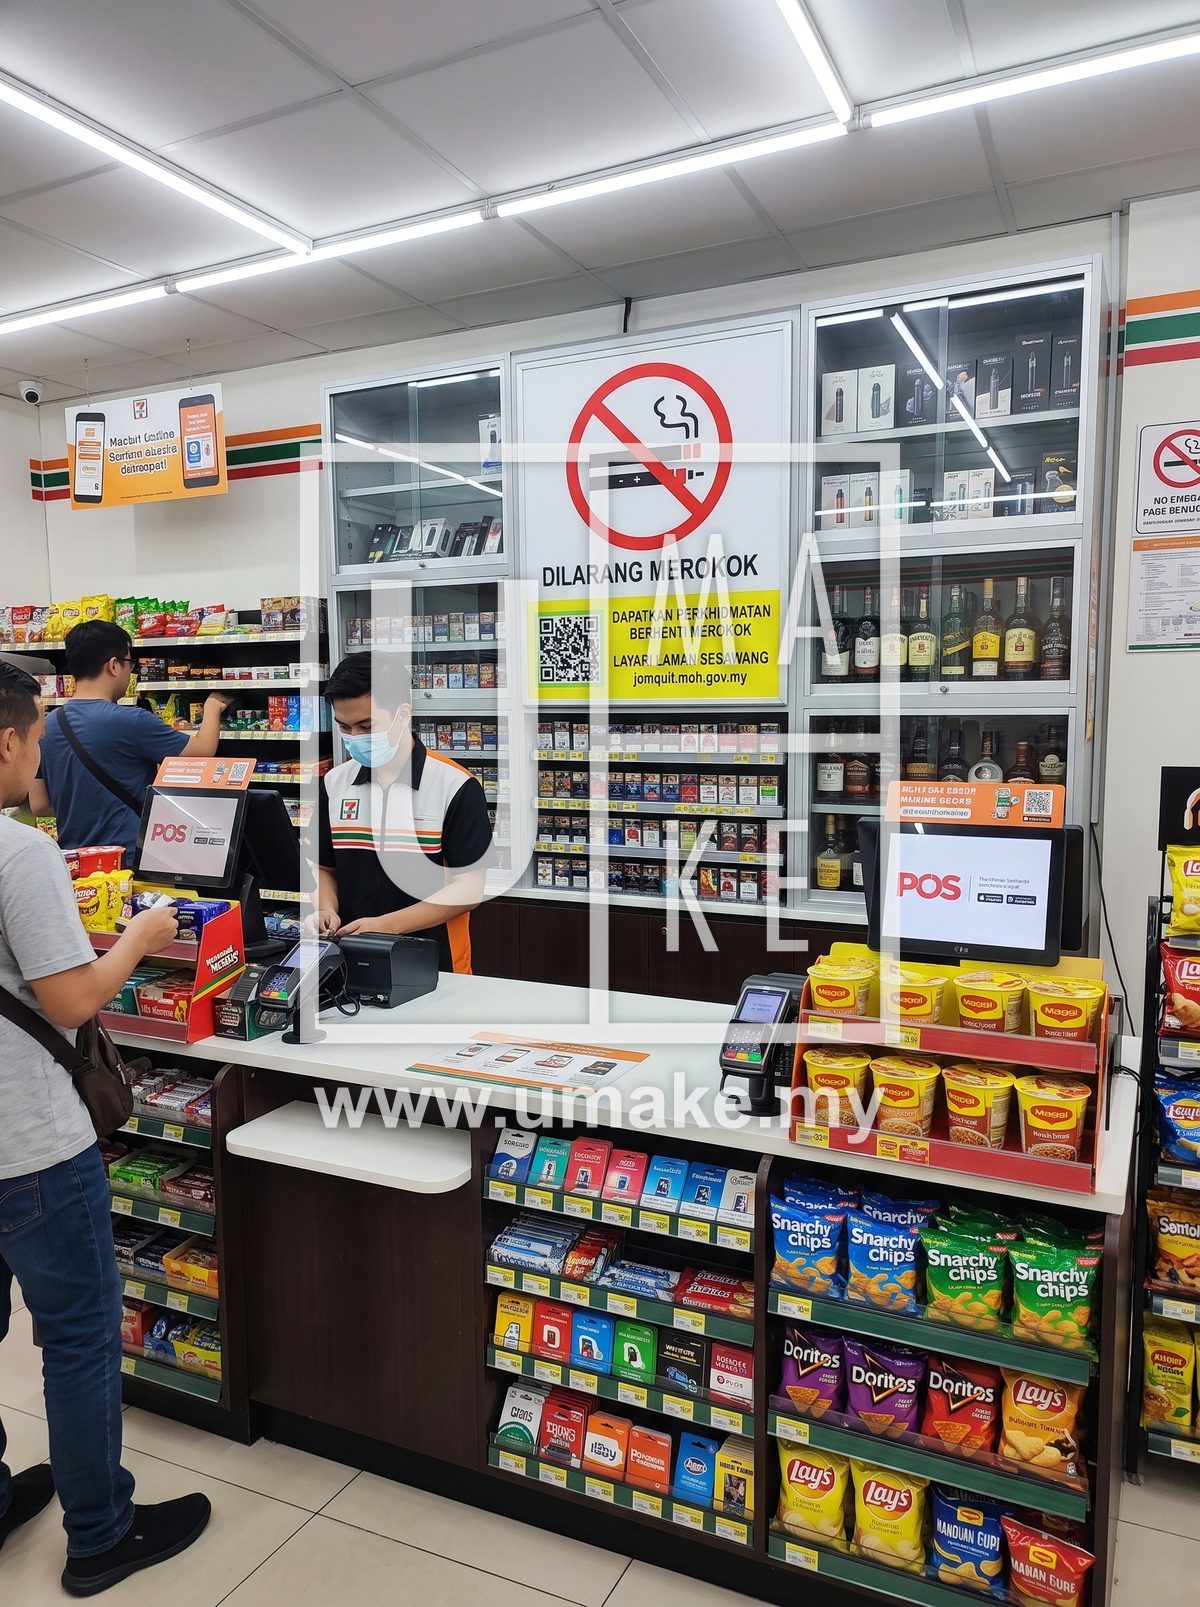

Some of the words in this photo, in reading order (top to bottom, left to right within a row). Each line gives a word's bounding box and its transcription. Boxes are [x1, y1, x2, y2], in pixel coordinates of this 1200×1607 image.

[1154, 496, 1168, 505] NO
[543, 561, 643, 587] DILARANG
[650, 554, 759, 581] MEROKOK
[612, 608, 673, 624] DAPATKAN
[677, 604, 771, 621] PERKHIDMATAN
[630, 625, 688, 640] BERHENTI
[690, 623, 752, 638] MEROKOK
[613, 654, 653, 668] LAYARI
[656, 652, 697, 667] LAMAN
[700, 650, 769, 665] SESAWANG
[633, 671, 747, 687] jomquit.moh.gov.my
[151, 823, 187, 843] POS
[897, 872, 962, 901] POS
[771, 1212, 832, 1237] Snarchy
[788, 1233, 832, 1251] chips
[851, 1227, 916, 1251] Snarchy
[868, 1248, 915, 1265] chips
[928, 1249, 998, 1270] Snarchy
[948, 1266, 998, 1284] chips
[1015, 1262, 1089, 1285] Snarchy
[1036, 1283, 1089, 1302] chips
[784, 1340, 840, 1369] Doritos
[852, 1365, 916, 1393] Doritos
[929, 1371, 994, 1403] Doritos
[1016, 1382, 1064, 1411] Lay's
[790, 1460, 832, 1489] Lay's
[865, 1482, 909, 1511] Lay's
